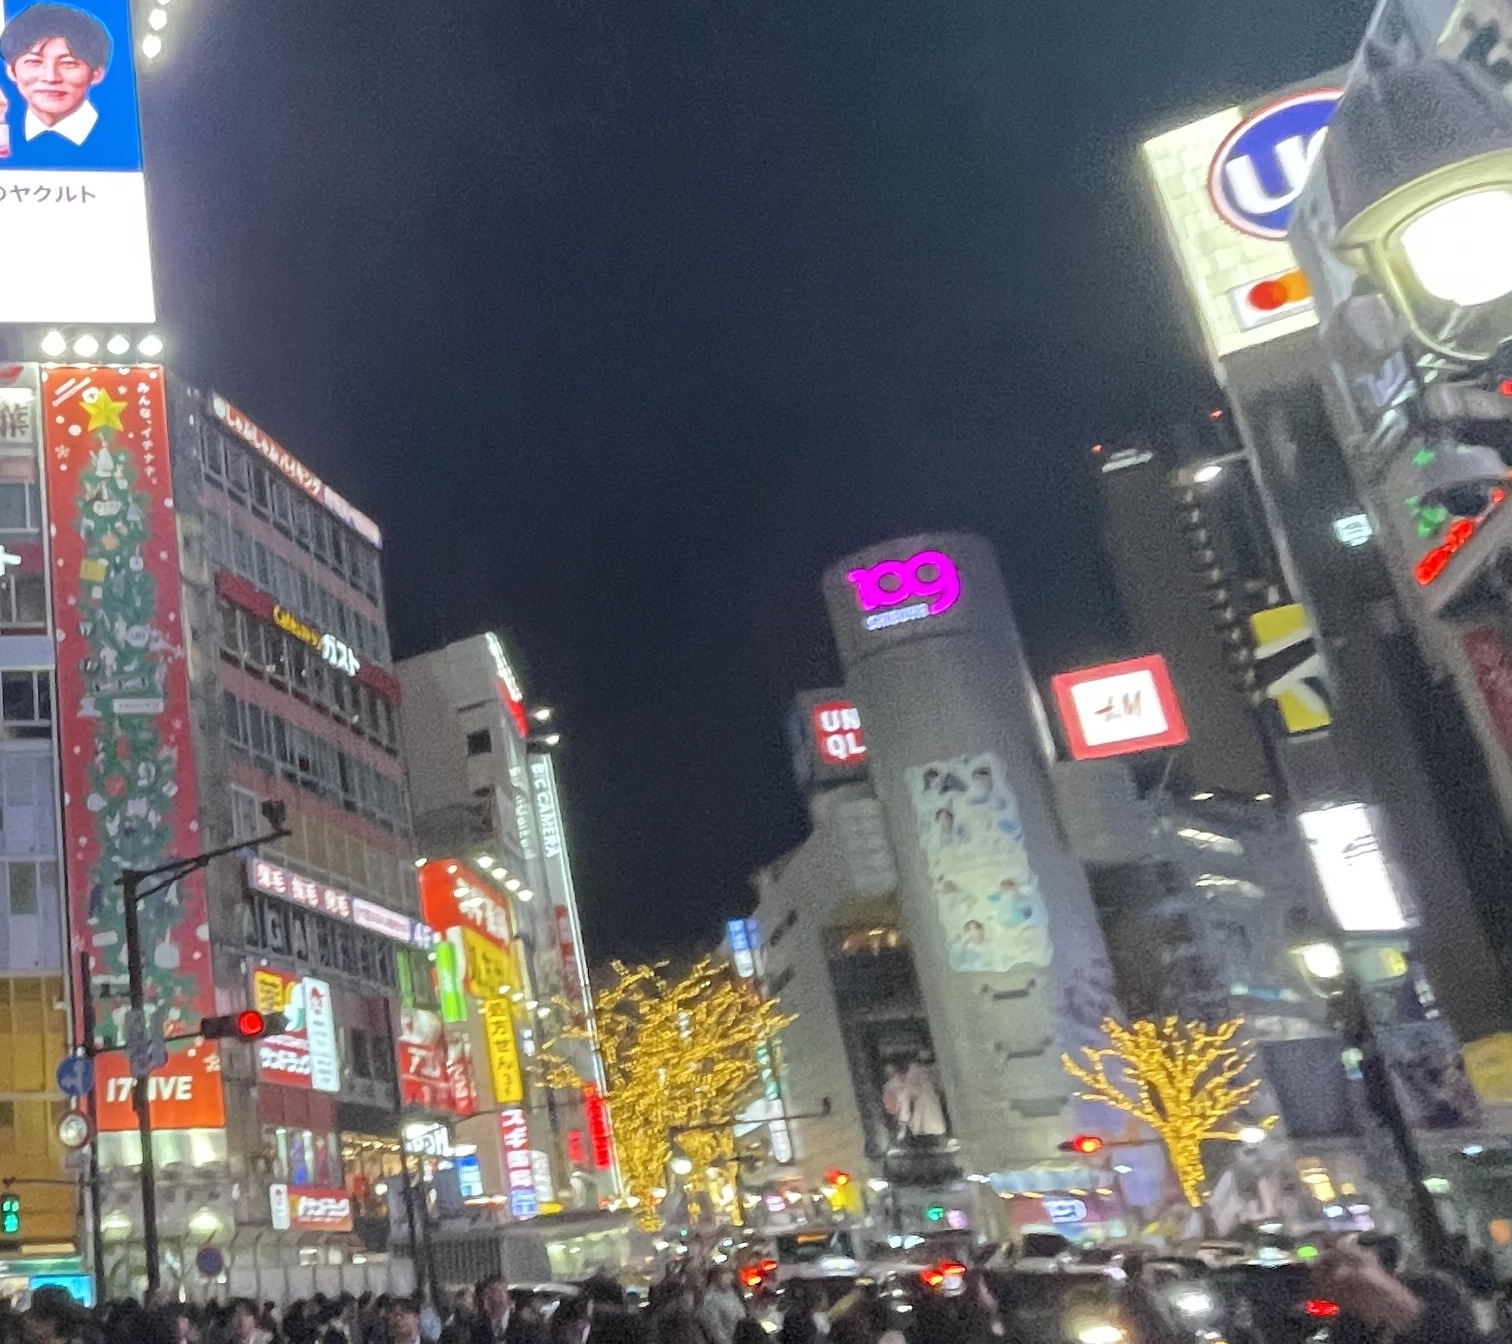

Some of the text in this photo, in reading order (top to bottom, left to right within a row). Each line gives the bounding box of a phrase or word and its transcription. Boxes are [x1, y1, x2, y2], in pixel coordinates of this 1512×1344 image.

[1225, 124, 1329, 215] U
[848, 550, 960, 615] 109
[106, 1075, 193, 1103] 17IVE
